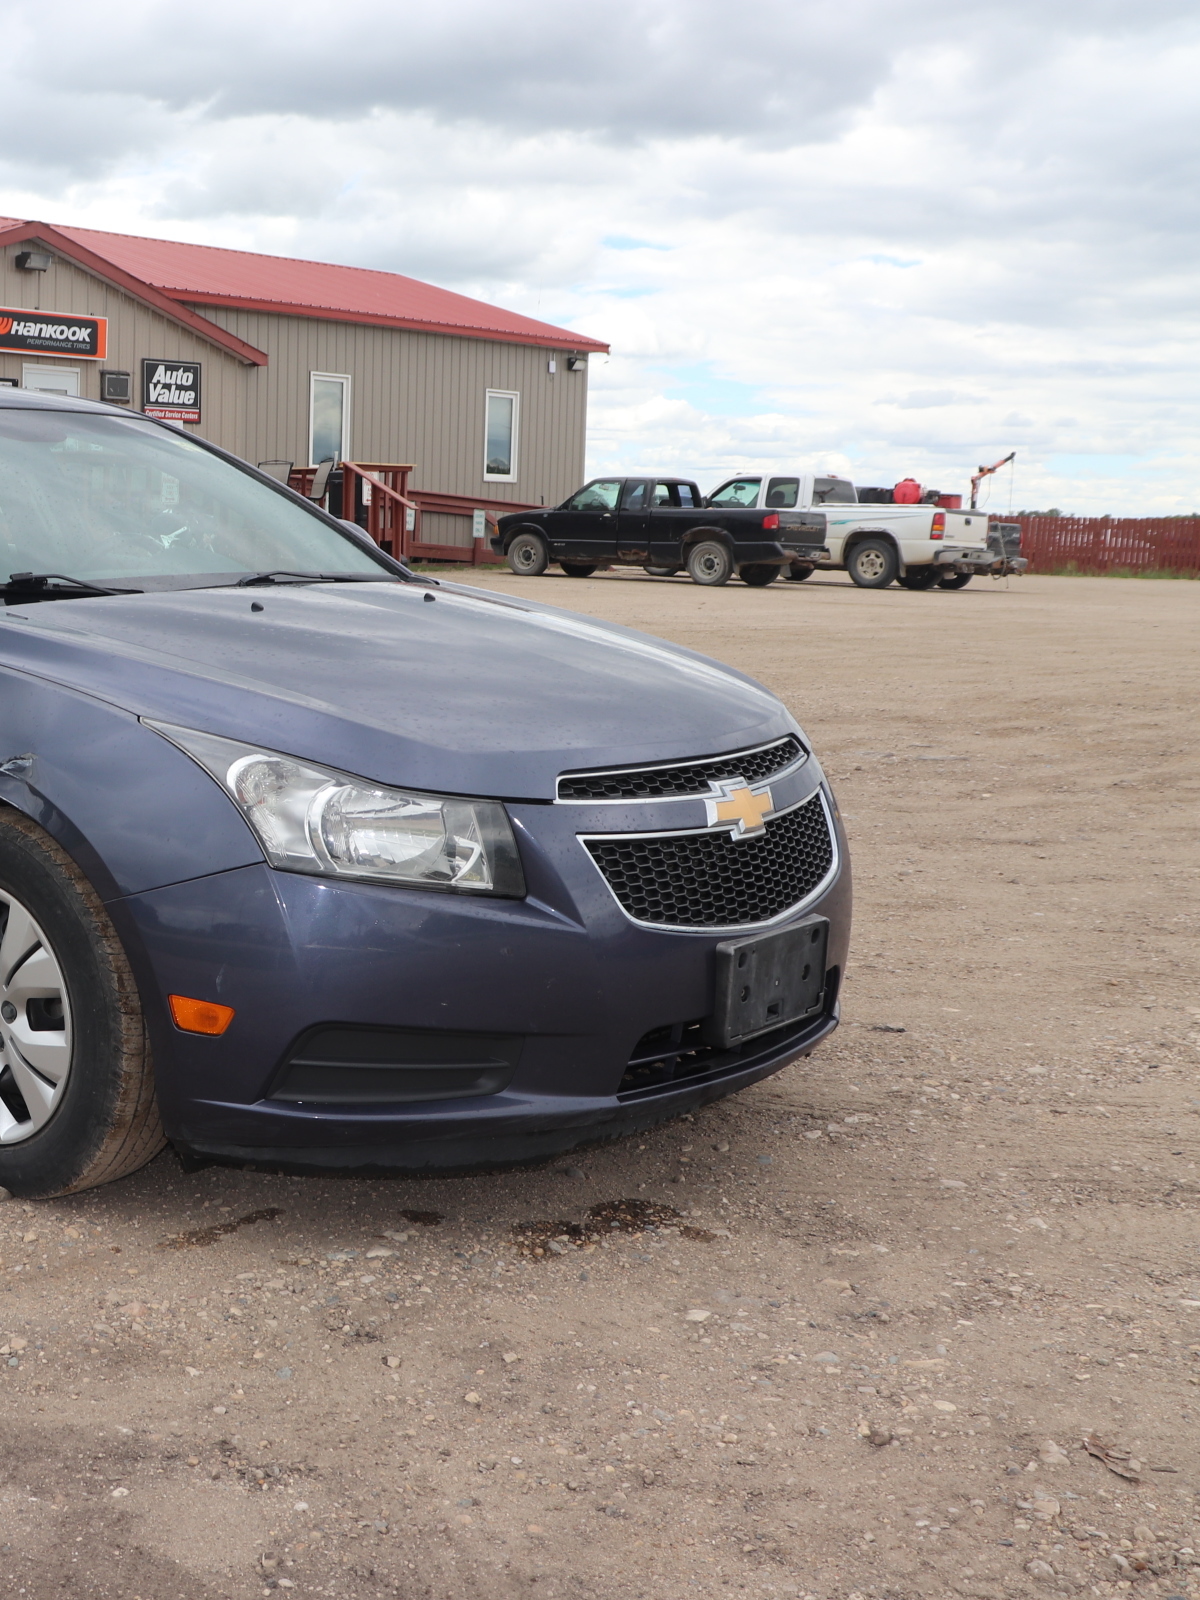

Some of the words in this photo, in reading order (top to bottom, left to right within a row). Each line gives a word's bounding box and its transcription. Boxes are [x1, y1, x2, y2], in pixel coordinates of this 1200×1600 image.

[26, 338, 72, 349] PERFORMANCE
[73, 341, 91, 350] TIRES
[151, 364, 194, 386] Auto
[149, 383, 196, 405] Value
[145, 410, 165, 418] Certified
[165, 410, 181, 418] Service
[181, 411, 198, 420] Centers
